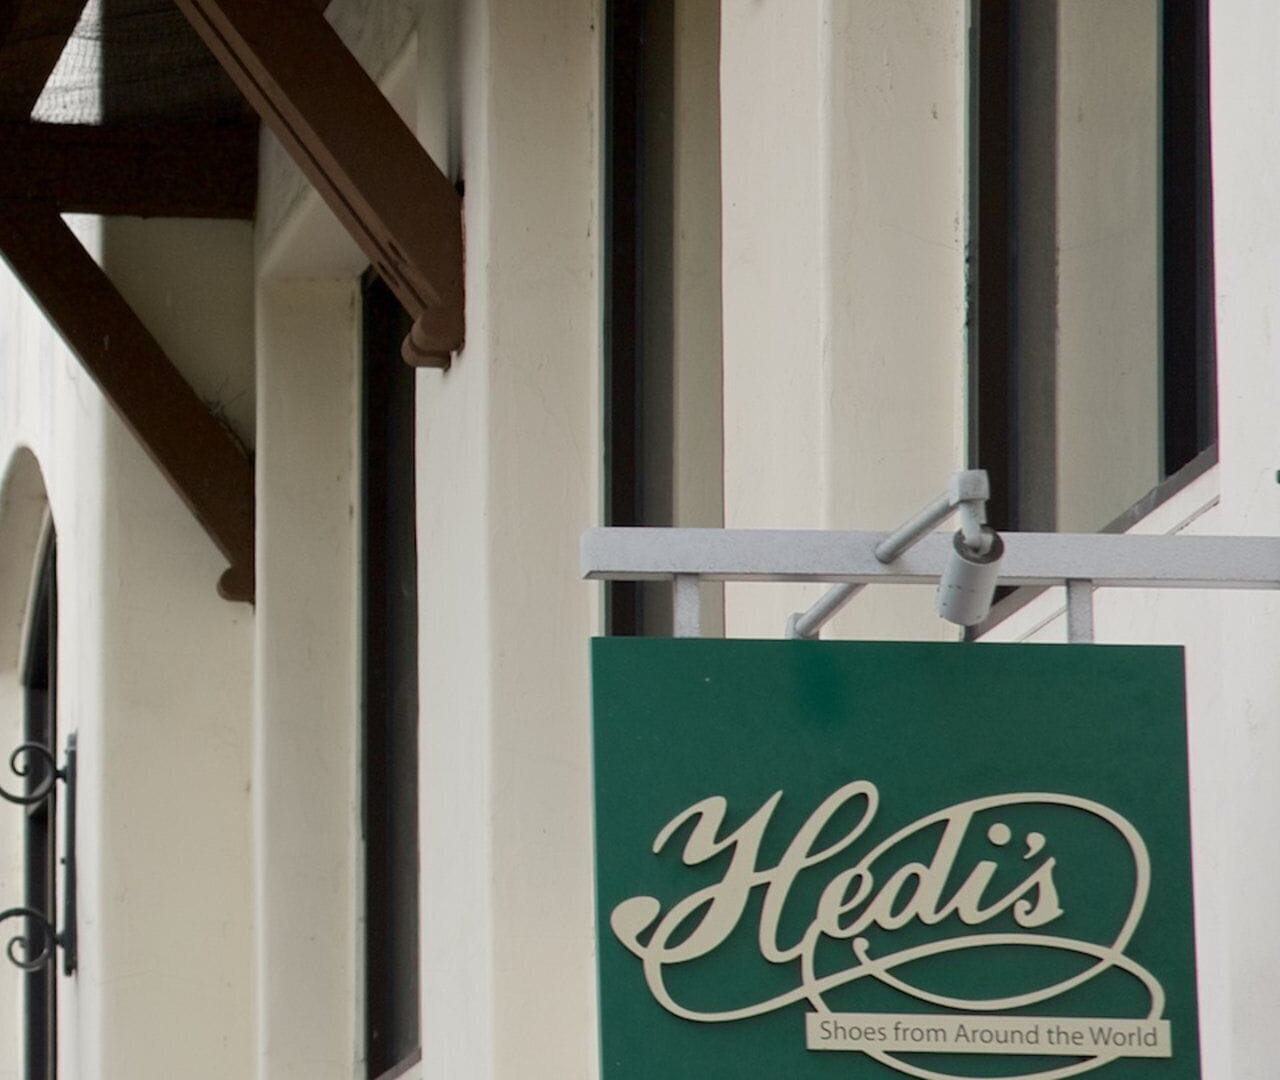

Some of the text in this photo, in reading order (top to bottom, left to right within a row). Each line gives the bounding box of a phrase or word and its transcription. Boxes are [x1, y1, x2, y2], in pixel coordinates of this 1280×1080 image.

[610, 780, 1151, 1000] Hedi's
[819, 1020, 1158, 1047] Shoes from Around the World
